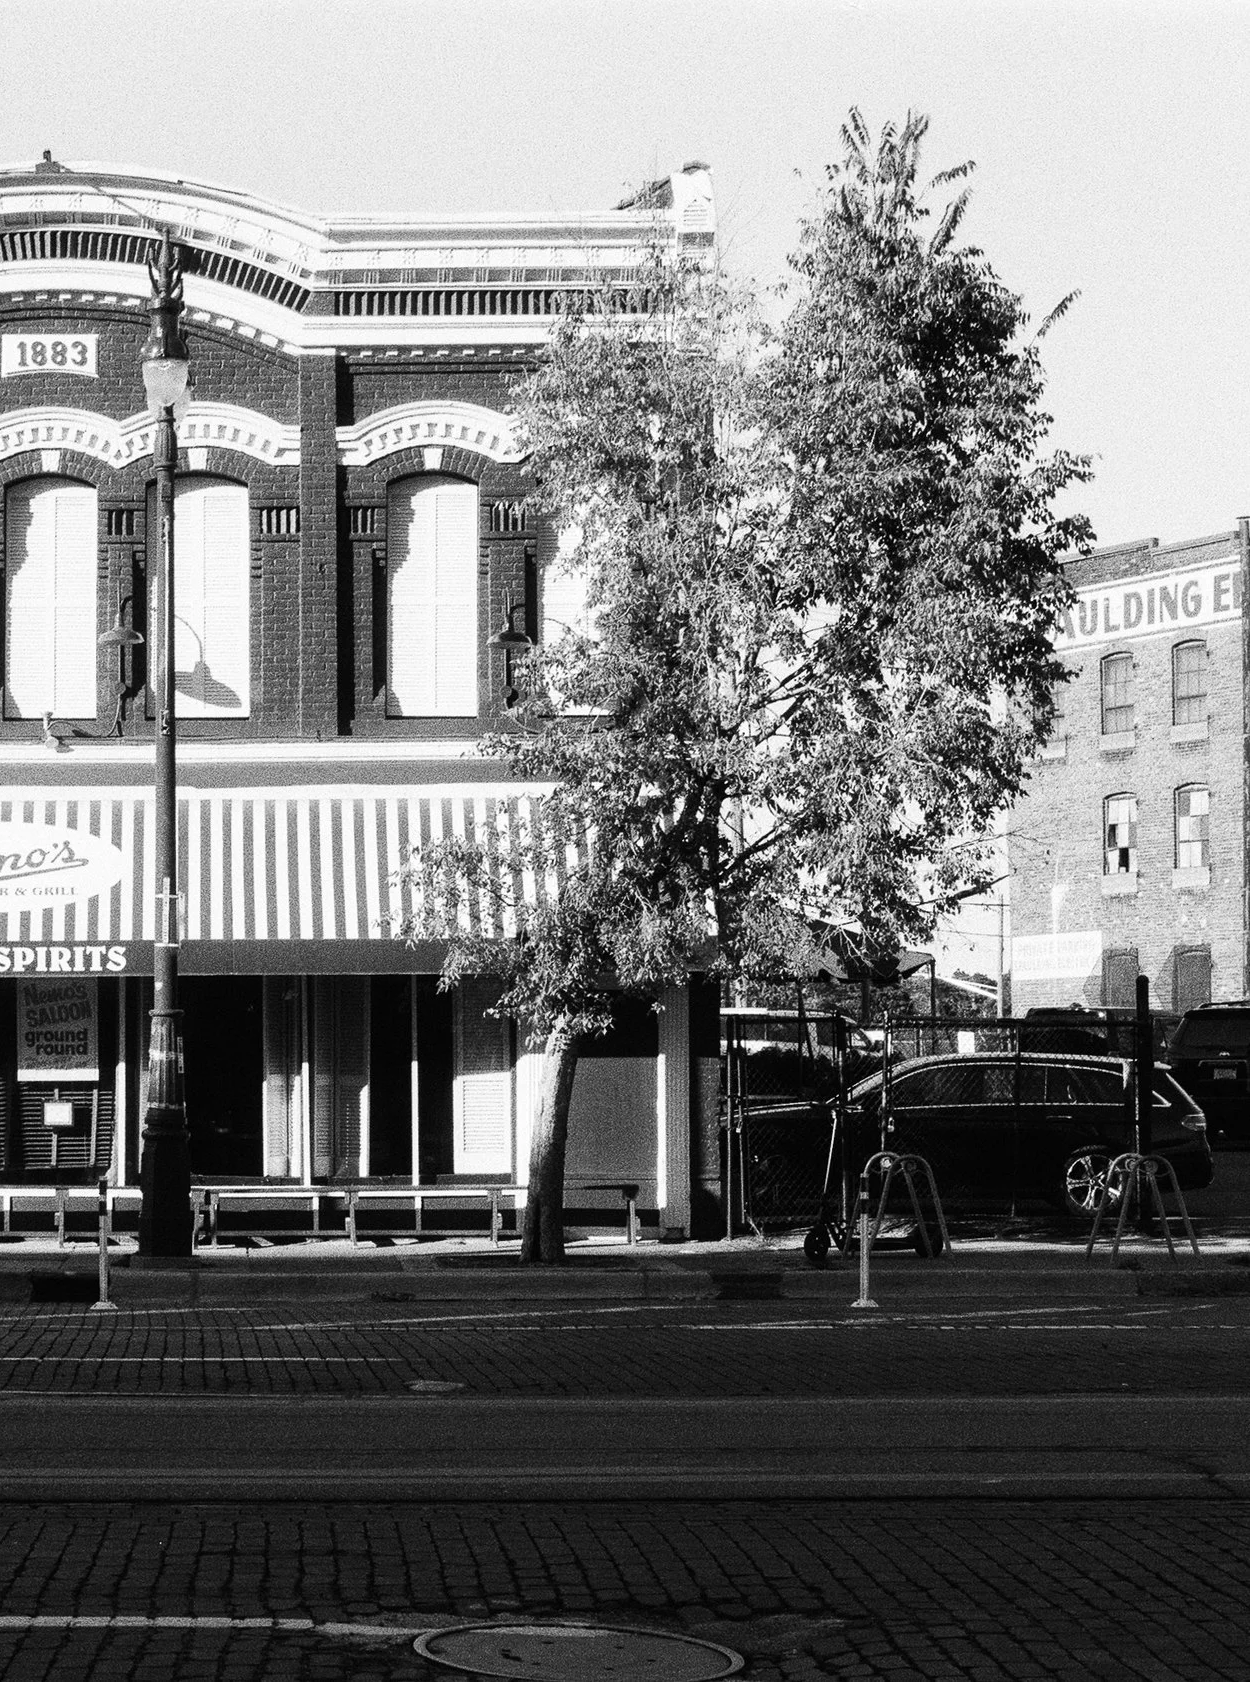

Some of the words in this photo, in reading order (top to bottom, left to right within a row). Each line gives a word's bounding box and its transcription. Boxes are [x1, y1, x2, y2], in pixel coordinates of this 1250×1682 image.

[16, 340, 89, 367] 1883
[14, 887, 28, 897] &
[32, 886, 79, 897] GRILL
[22, 982, 89, 1006] Nemo's
[25, 1000, 92, 1028] SALOON
[24, 1028, 89, 1048] ground
[35, 1041, 89, 1056] round
